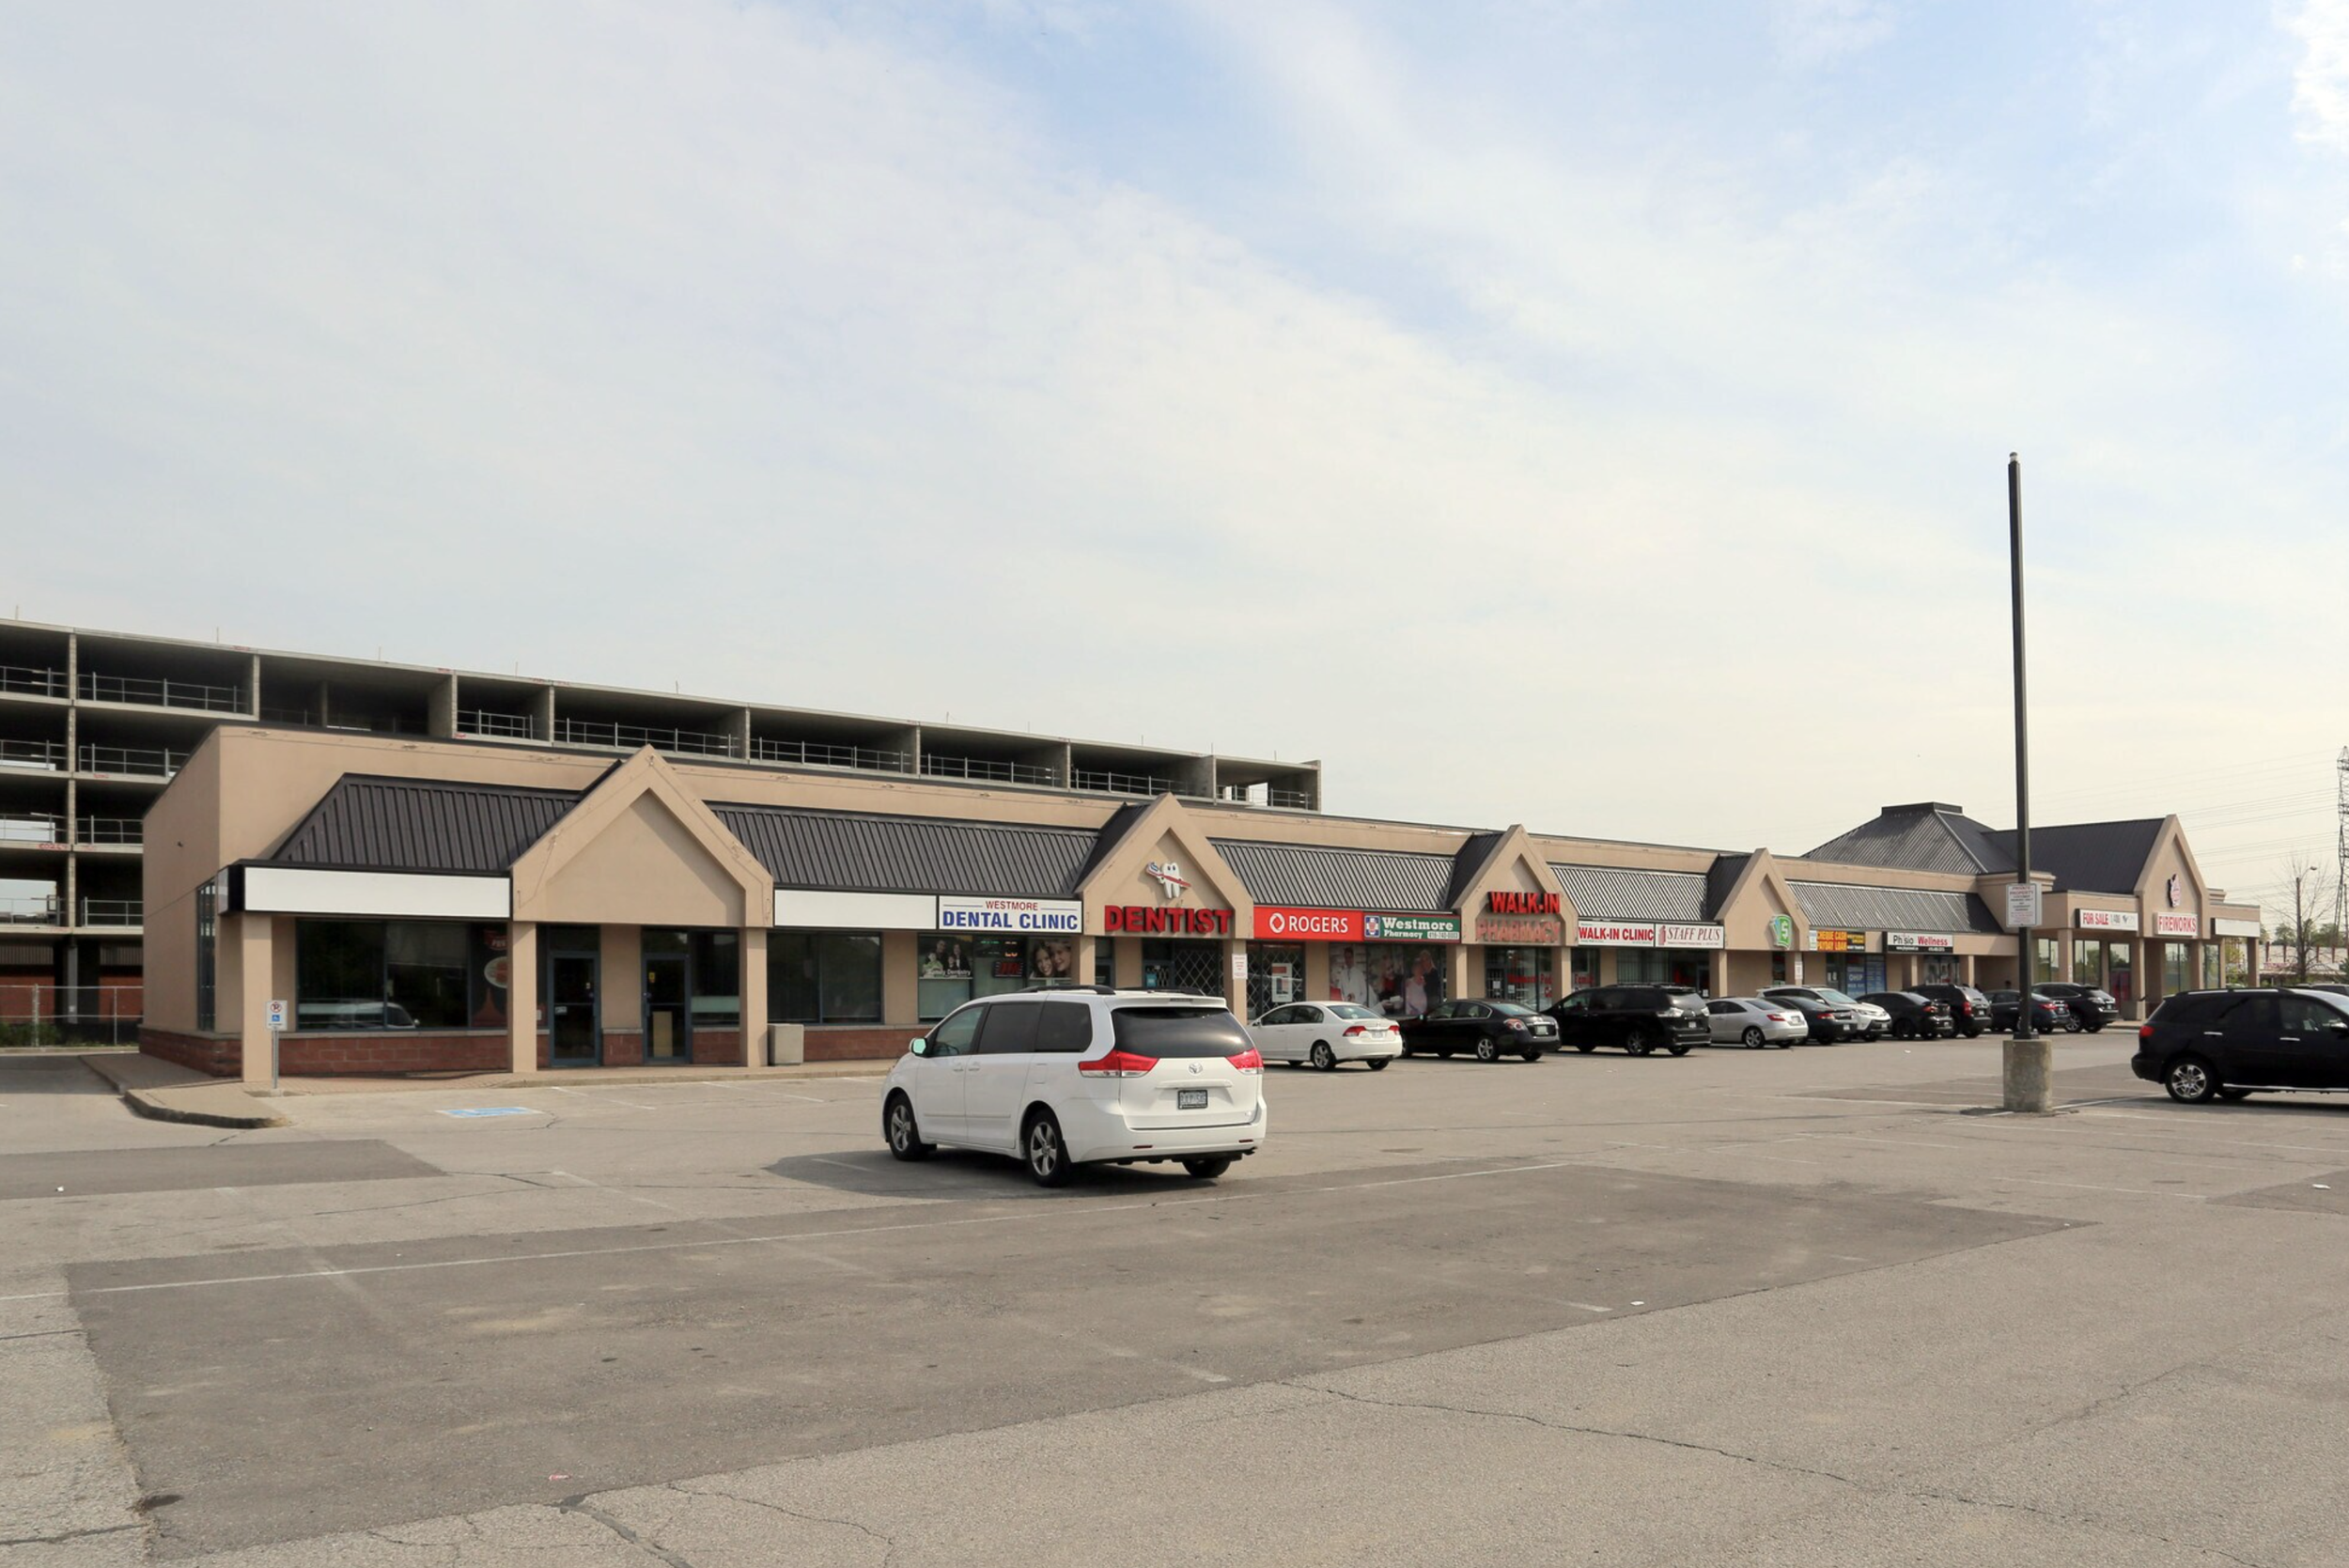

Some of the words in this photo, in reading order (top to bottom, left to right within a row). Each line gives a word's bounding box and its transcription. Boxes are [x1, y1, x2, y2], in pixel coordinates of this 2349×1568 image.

[986, 900, 1038, 911] WESTMORE
[1489, 891, 1560, 914] WALK-IN
[942, 909, 1013, 928] DENTAL
[1019, 913, 1078, 931] CLINIC
[1104, 905, 1233, 934] DENTIST
[1288, 915, 1348, 934] ROGERS
[1382, 917, 1454, 931] Westmore
[2083, 912, 2093, 924] FOR
[2095, 912, 2108, 925] SALE
[2158, 915, 2197, 932] FIREWORKS
[1384, 929, 1423, 939] Pharmacy
[1476, 918, 1561, 943] PHARMACY
[1579, 926, 1620, 940] WALK-IN
[1622, 927, 1655, 941] CLINIC
[1668, 926, 1696, 940] STAFF
[1698, 927, 1721, 941] PLUS
[1917, 936, 1949, 946] Wellness
